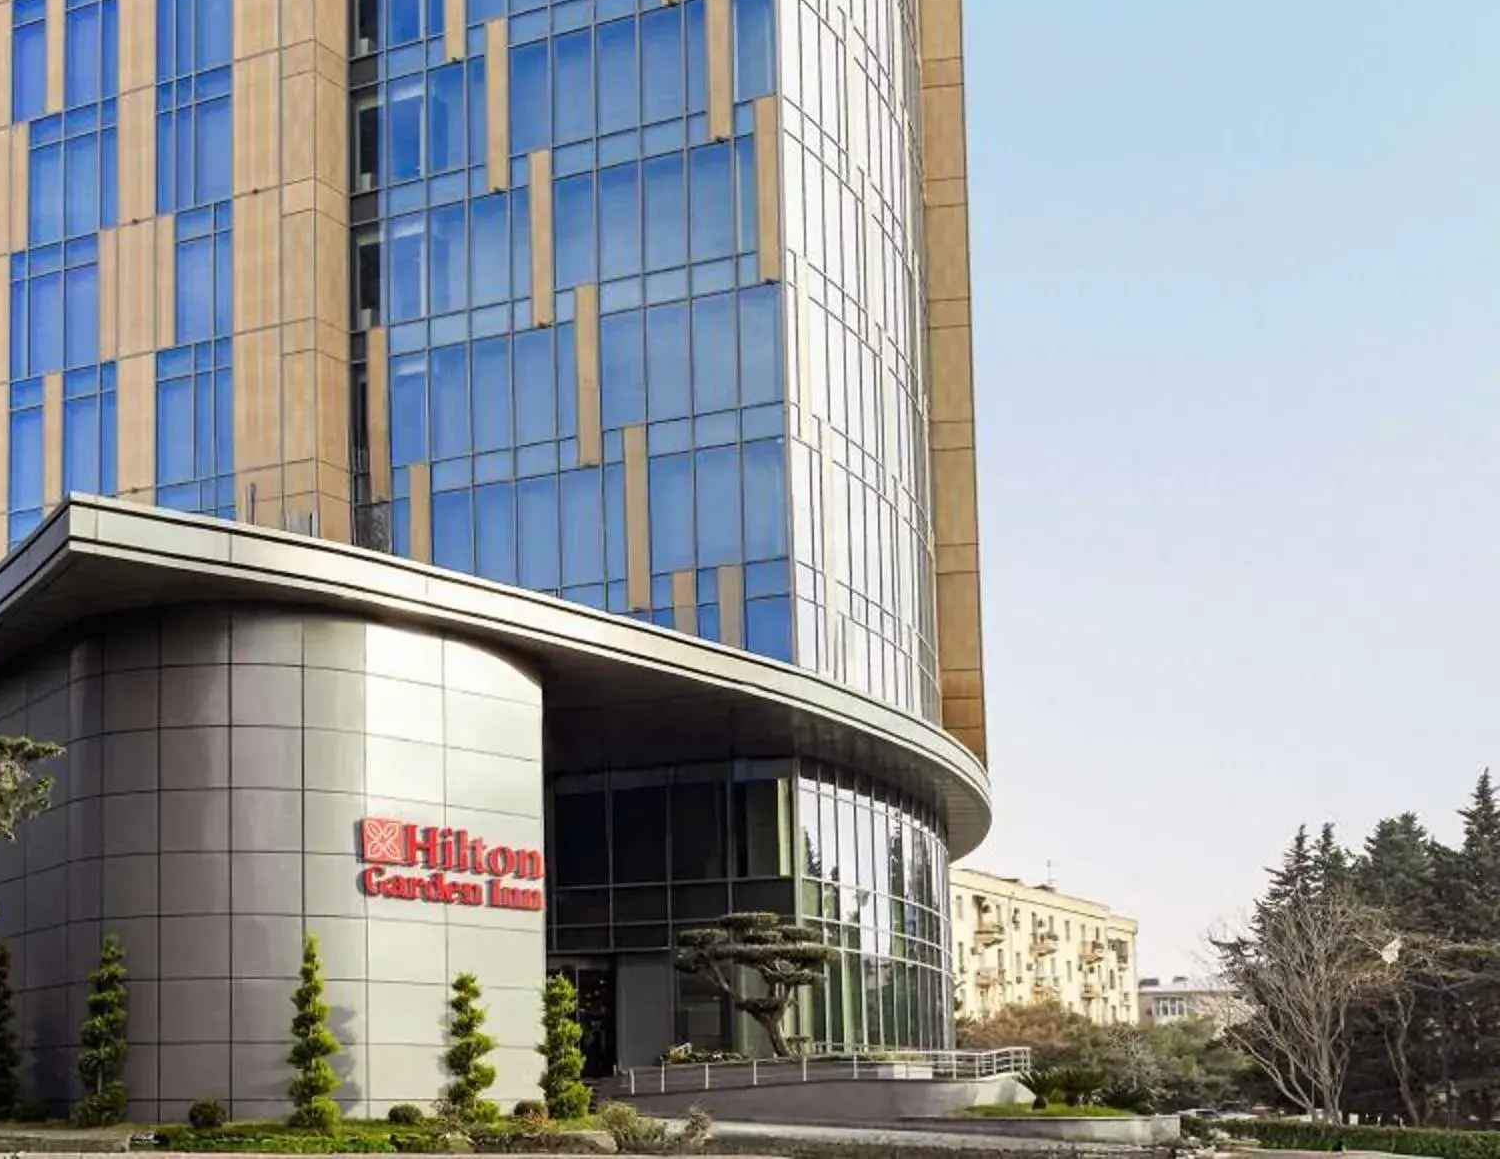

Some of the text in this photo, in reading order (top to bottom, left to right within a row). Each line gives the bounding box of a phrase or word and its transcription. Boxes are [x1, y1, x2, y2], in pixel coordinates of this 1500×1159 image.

[403, 824, 543, 879] Hilton
[363, 866, 543, 910] Garden Inn
